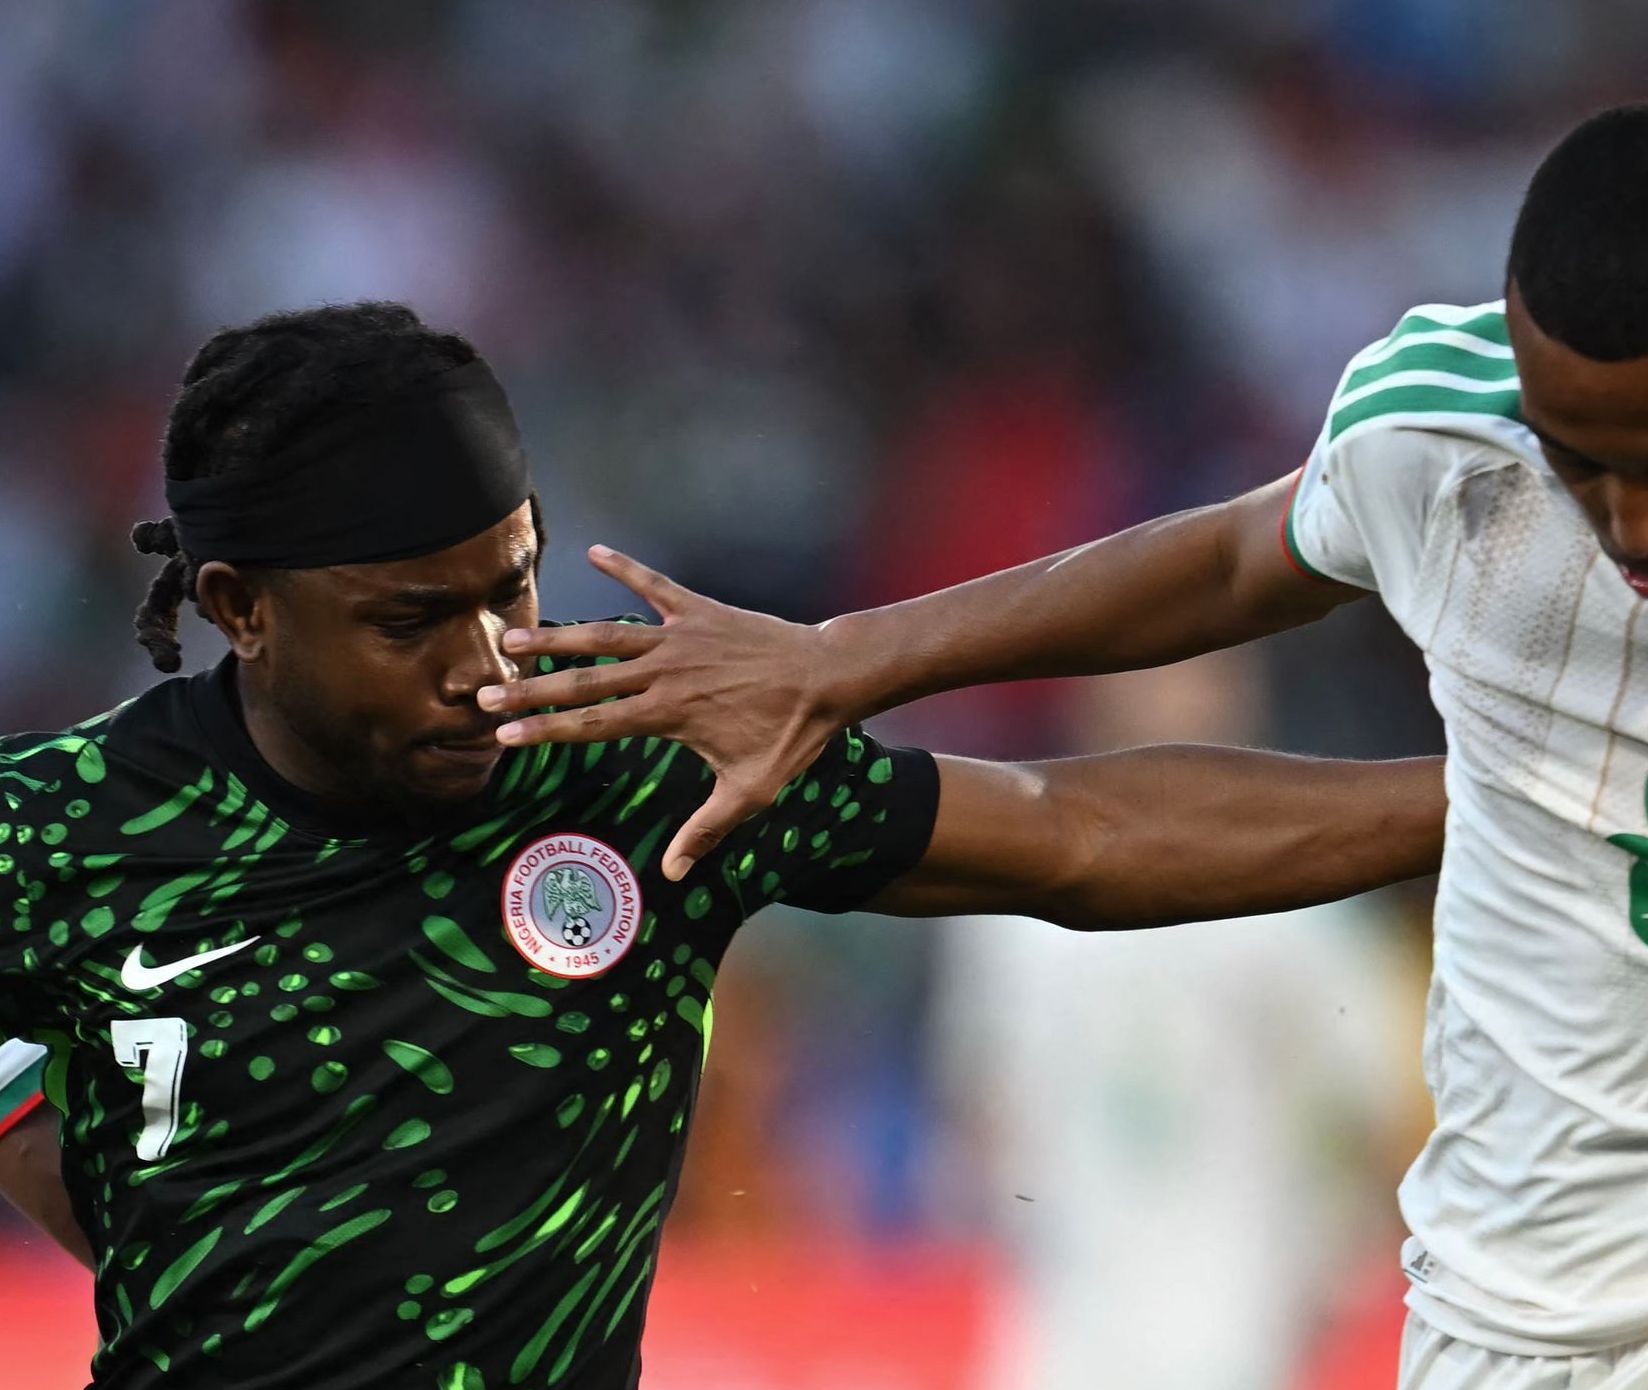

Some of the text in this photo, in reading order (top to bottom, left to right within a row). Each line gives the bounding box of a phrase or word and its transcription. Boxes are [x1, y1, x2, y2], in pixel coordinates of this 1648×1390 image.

[510, 840, 634, 955] NIGERIA FOOTBALL FEDERATION
[565, 952, 600, 968] 1945
[110, 1017, 188, 1161] 7
